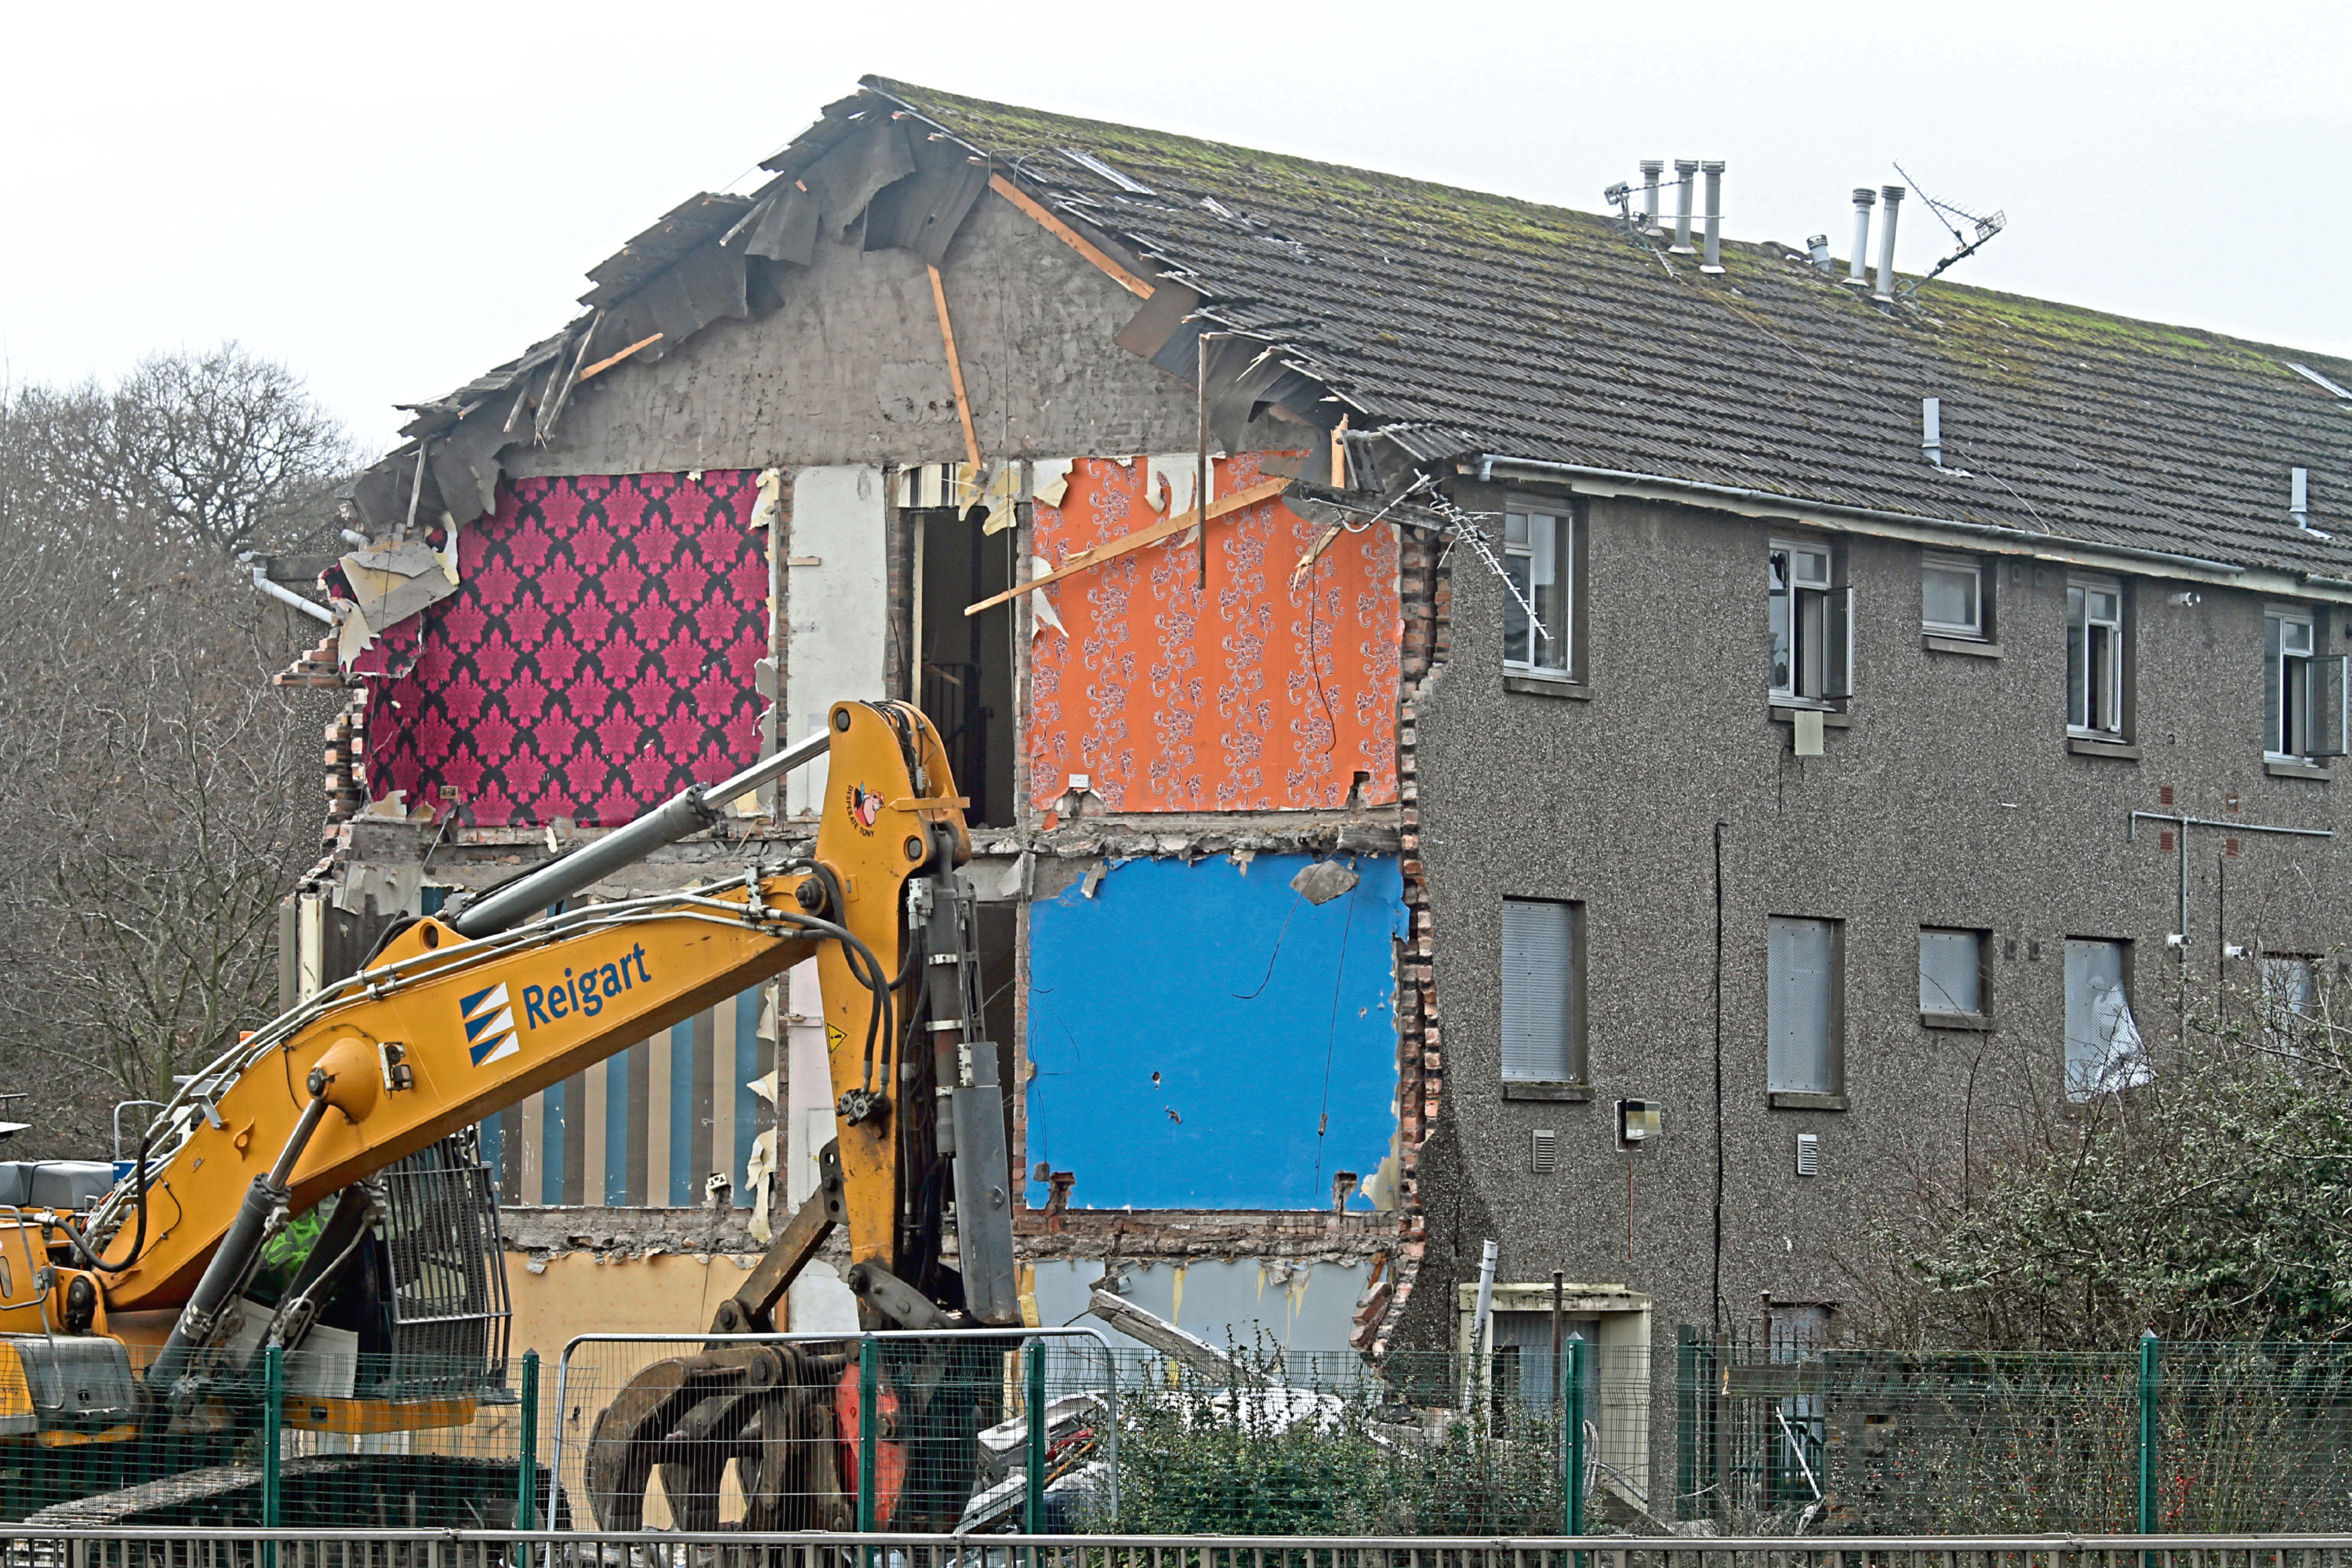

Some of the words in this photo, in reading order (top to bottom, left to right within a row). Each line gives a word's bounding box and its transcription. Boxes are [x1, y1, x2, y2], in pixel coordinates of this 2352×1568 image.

[846, 785, 859, 829] DESPERATE
[859, 826, 874, 837] TONY
[522, 942, 652, 1030] Reigart
